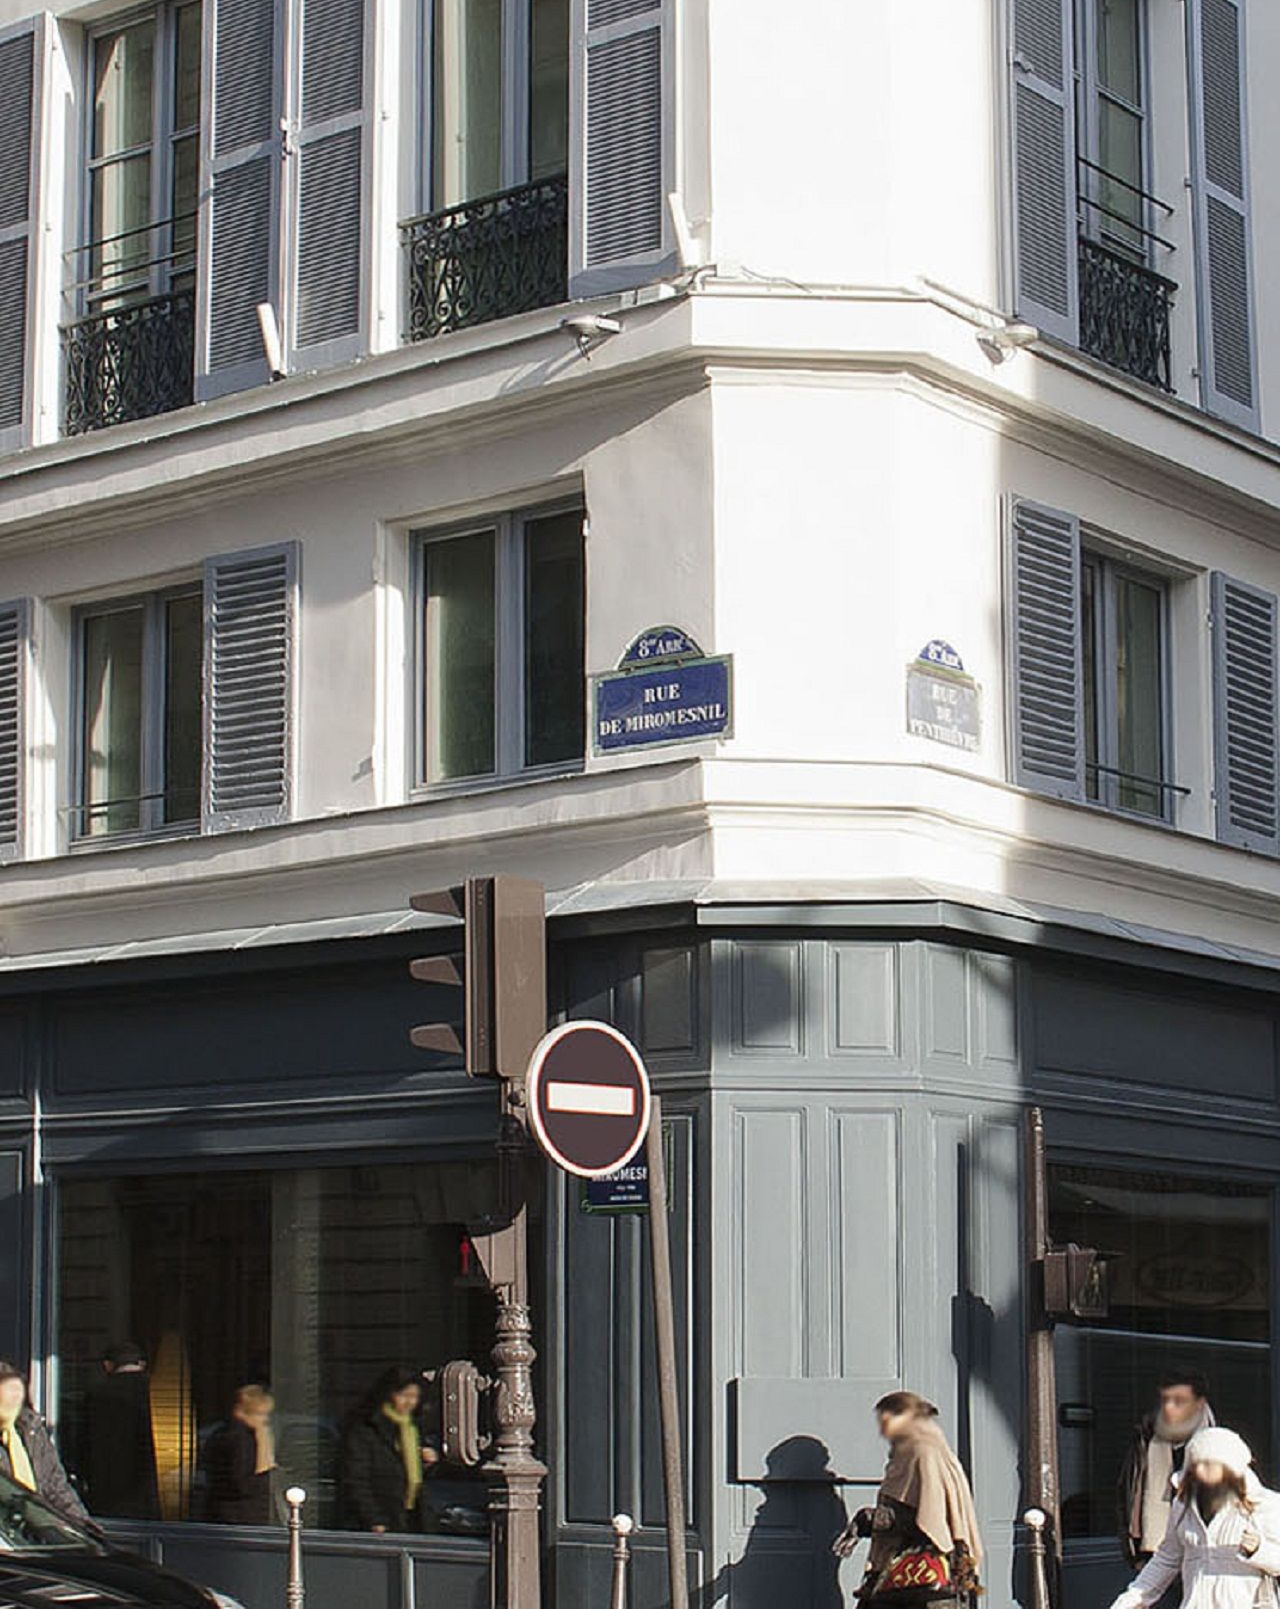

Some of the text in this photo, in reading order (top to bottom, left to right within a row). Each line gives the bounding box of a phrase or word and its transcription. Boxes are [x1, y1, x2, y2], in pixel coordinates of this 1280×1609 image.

[644, 683, 680, 703] RUE
[600, 703, 725, 736] DE MIROMESNIL
